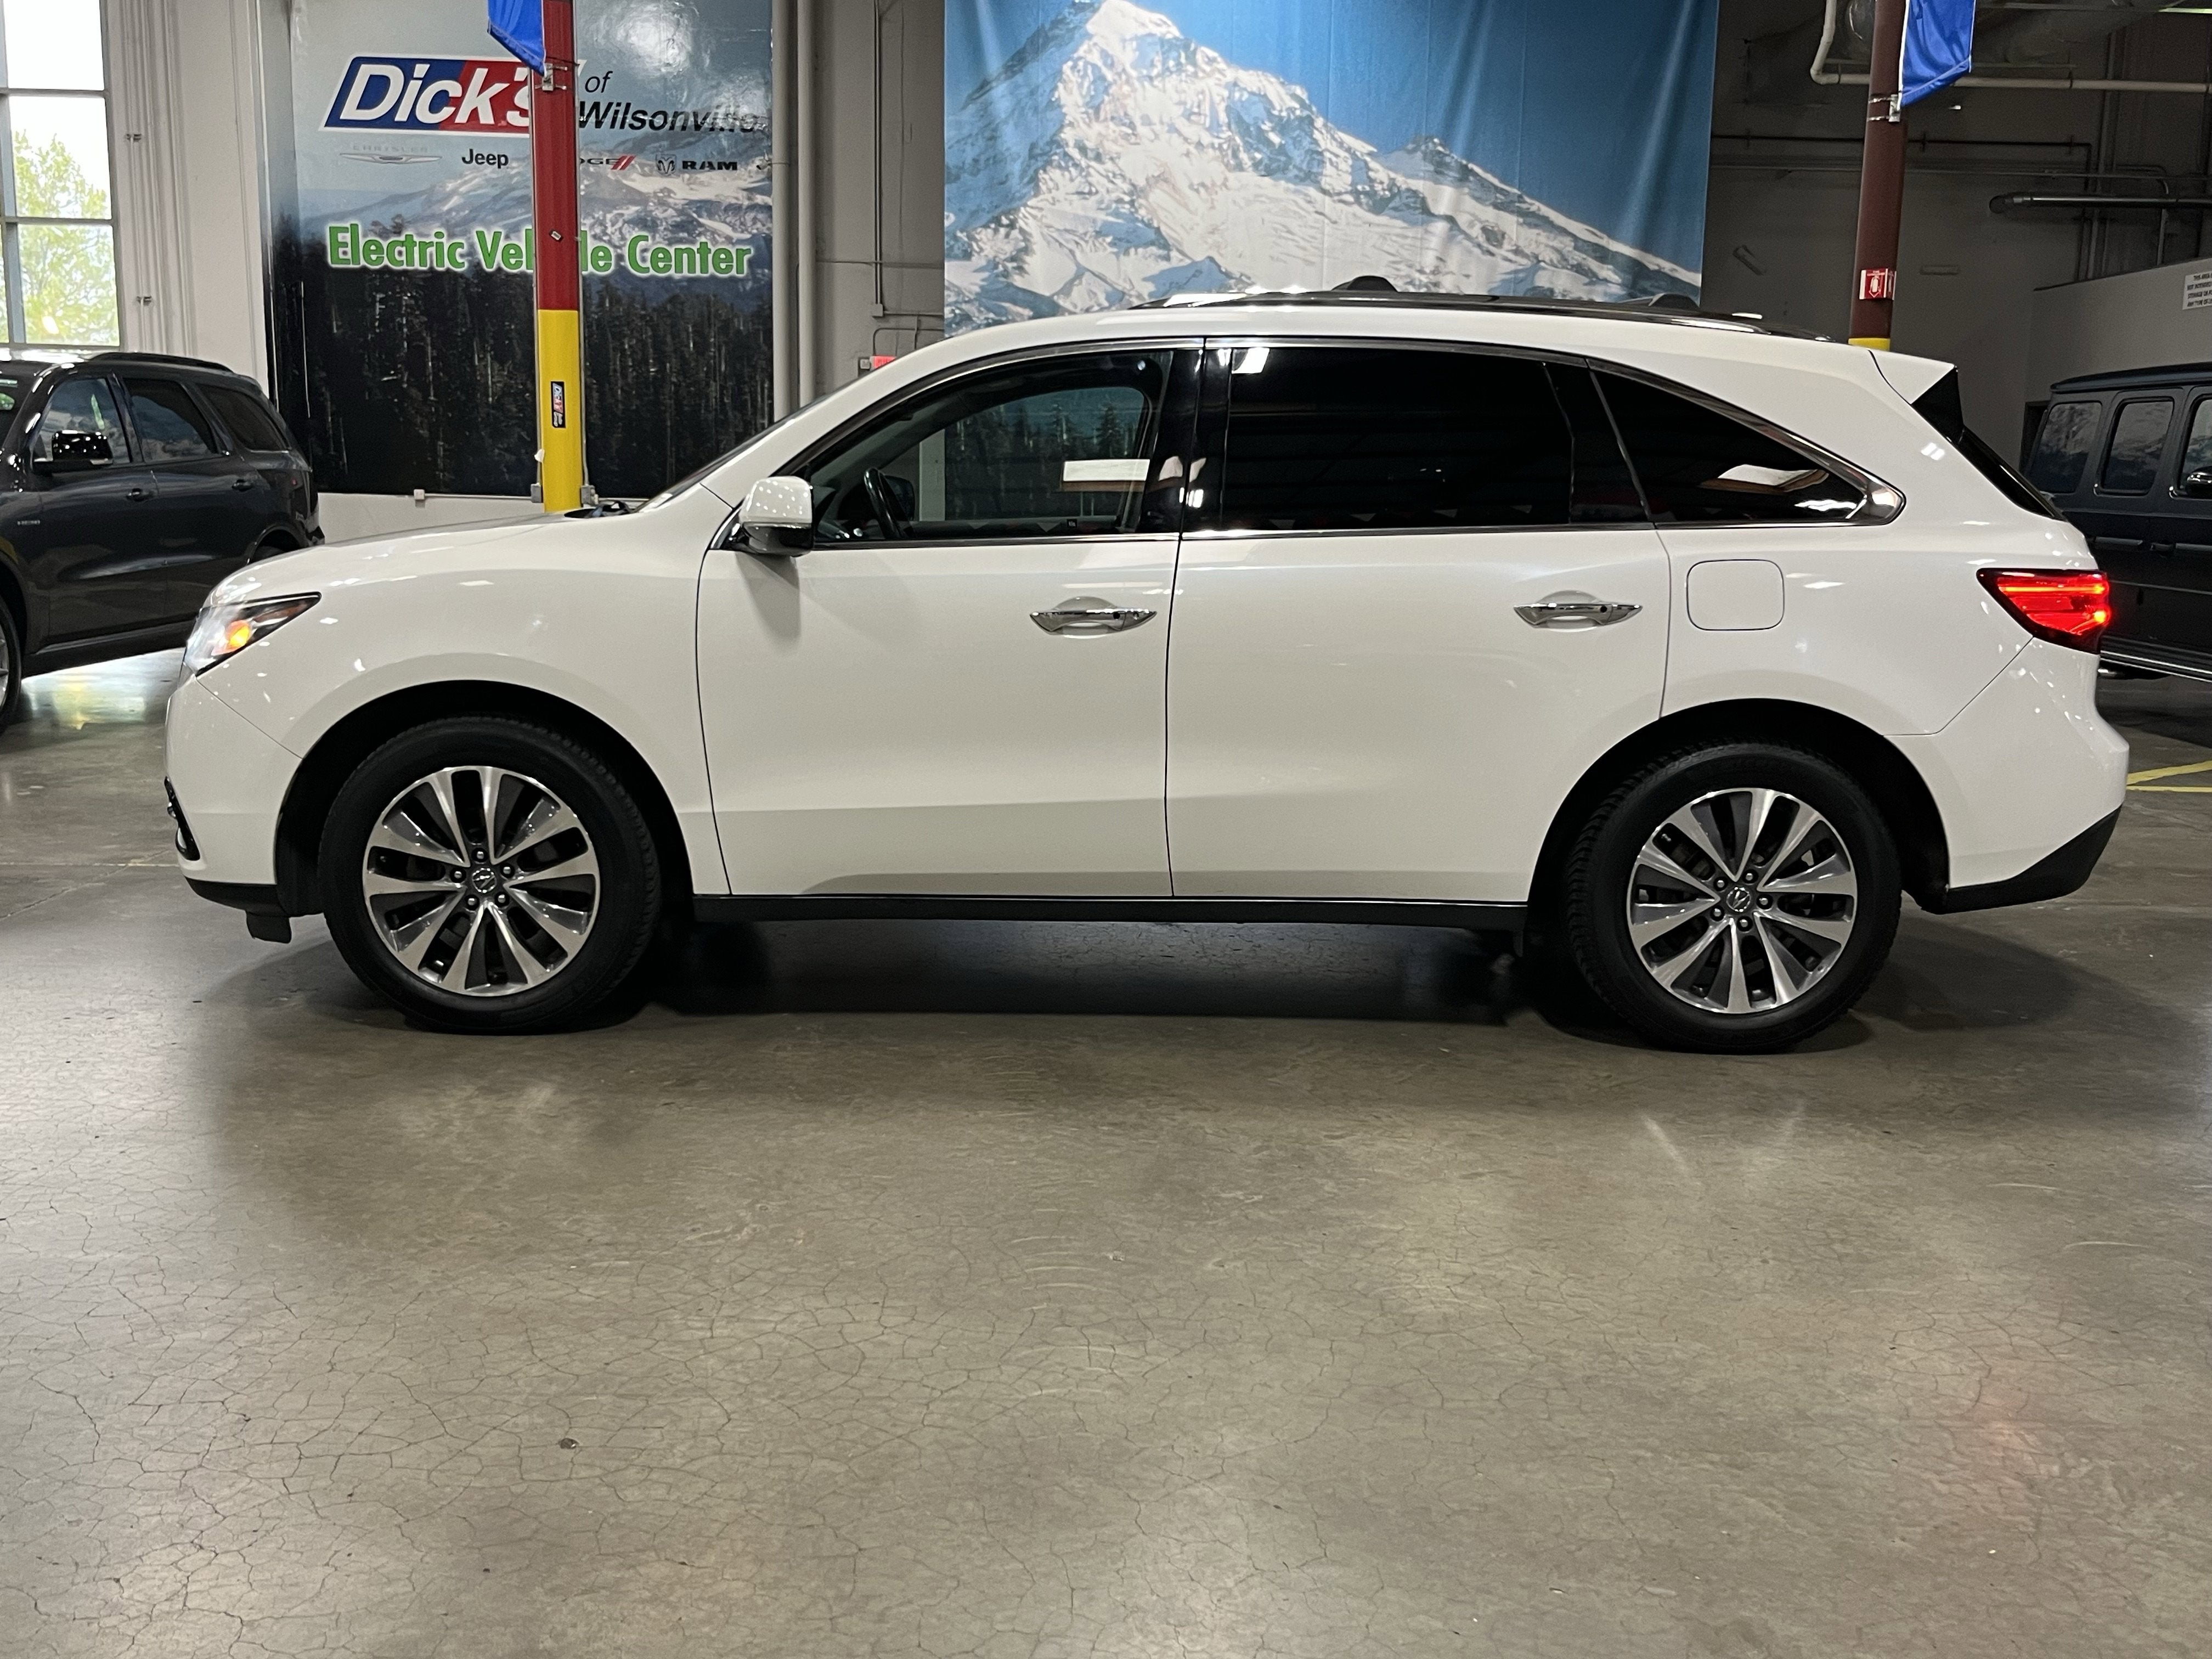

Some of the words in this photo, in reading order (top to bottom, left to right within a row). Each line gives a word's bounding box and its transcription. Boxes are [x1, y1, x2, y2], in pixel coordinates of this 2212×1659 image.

[585, 71, 613, 93] of
[579, 100, 755, 133] Wilsonv
[461, 148, 509, 168] Jeep
[682, 160, 738, 171] RAM
[329, 223, 465, 269] Electric
[475, 228, 612, 273] Vele
[628, 235, 752, 274] Center
